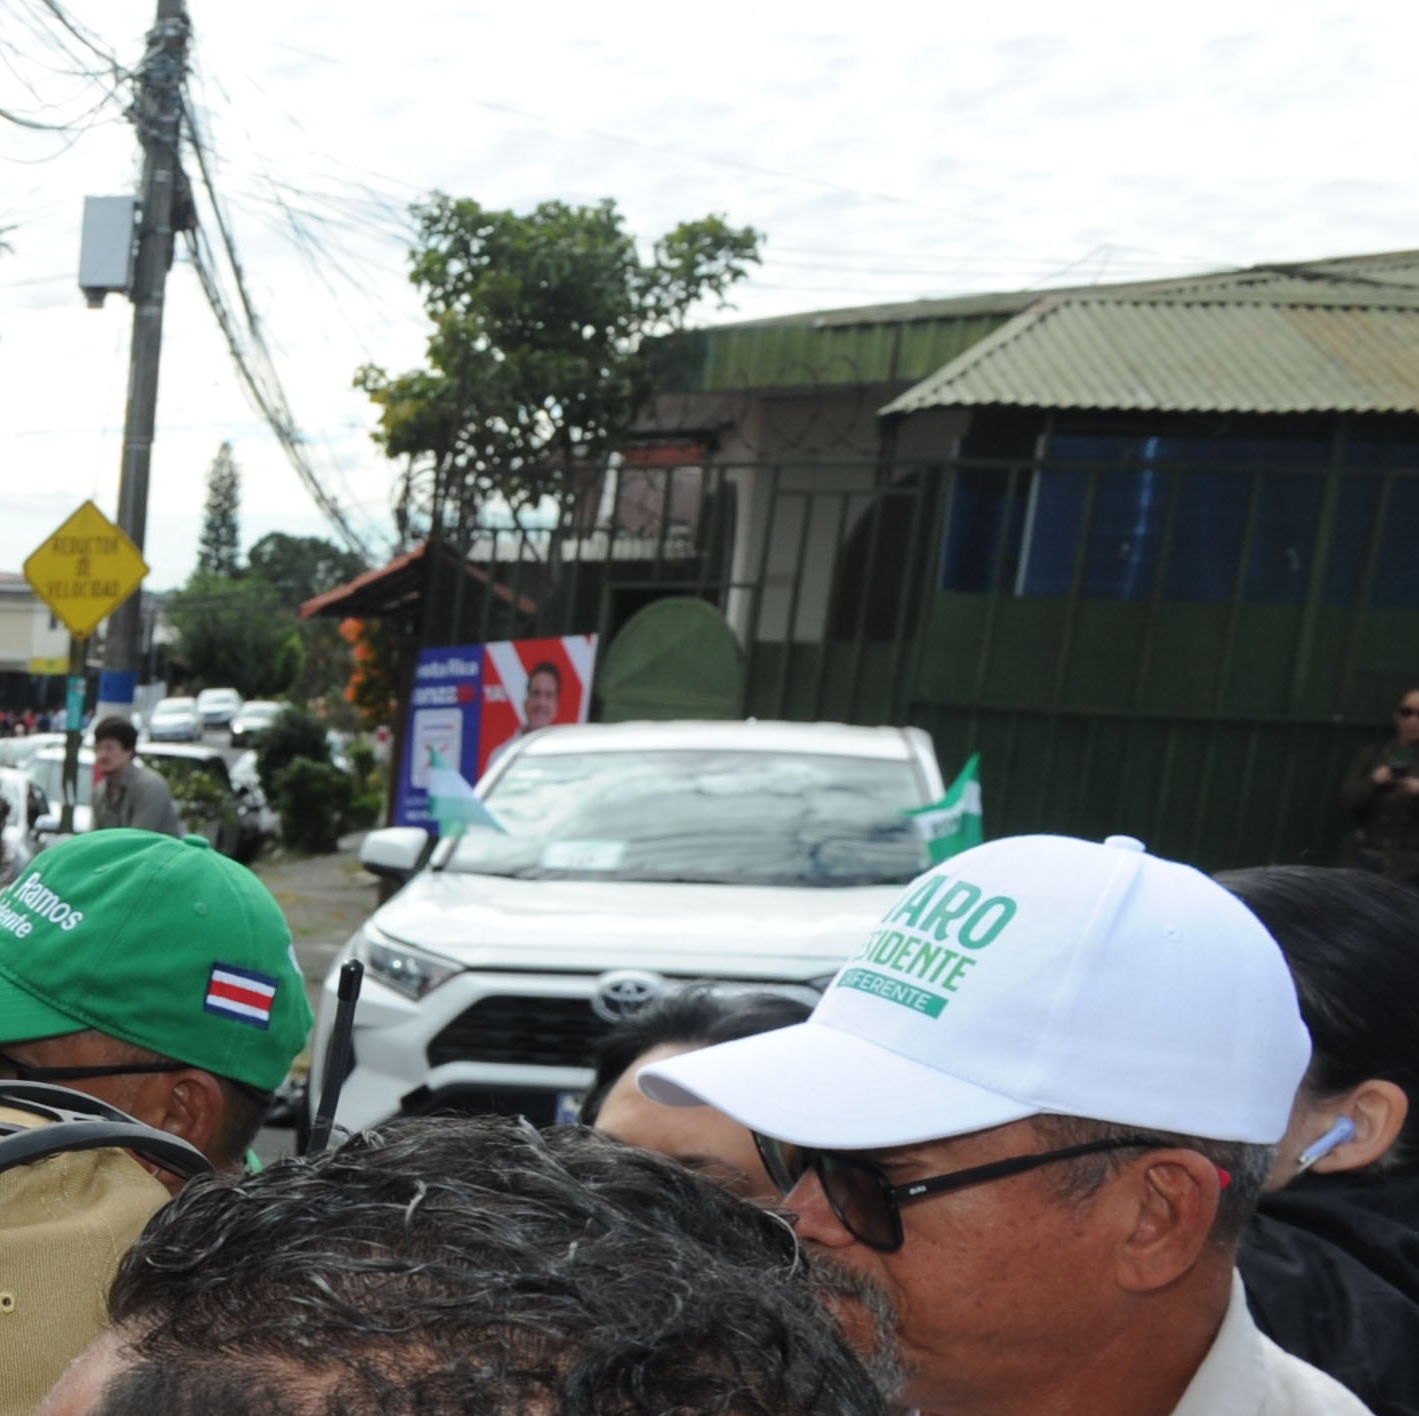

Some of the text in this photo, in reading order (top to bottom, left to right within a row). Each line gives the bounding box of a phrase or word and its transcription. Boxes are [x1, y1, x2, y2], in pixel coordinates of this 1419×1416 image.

[52, 536, 120, 554] REDUCTOR
[46, 581, 120, 598] VELOCIDAD
[13, 871, 84, 931] Ramos
[890, 874, 1018, 950] ARO
